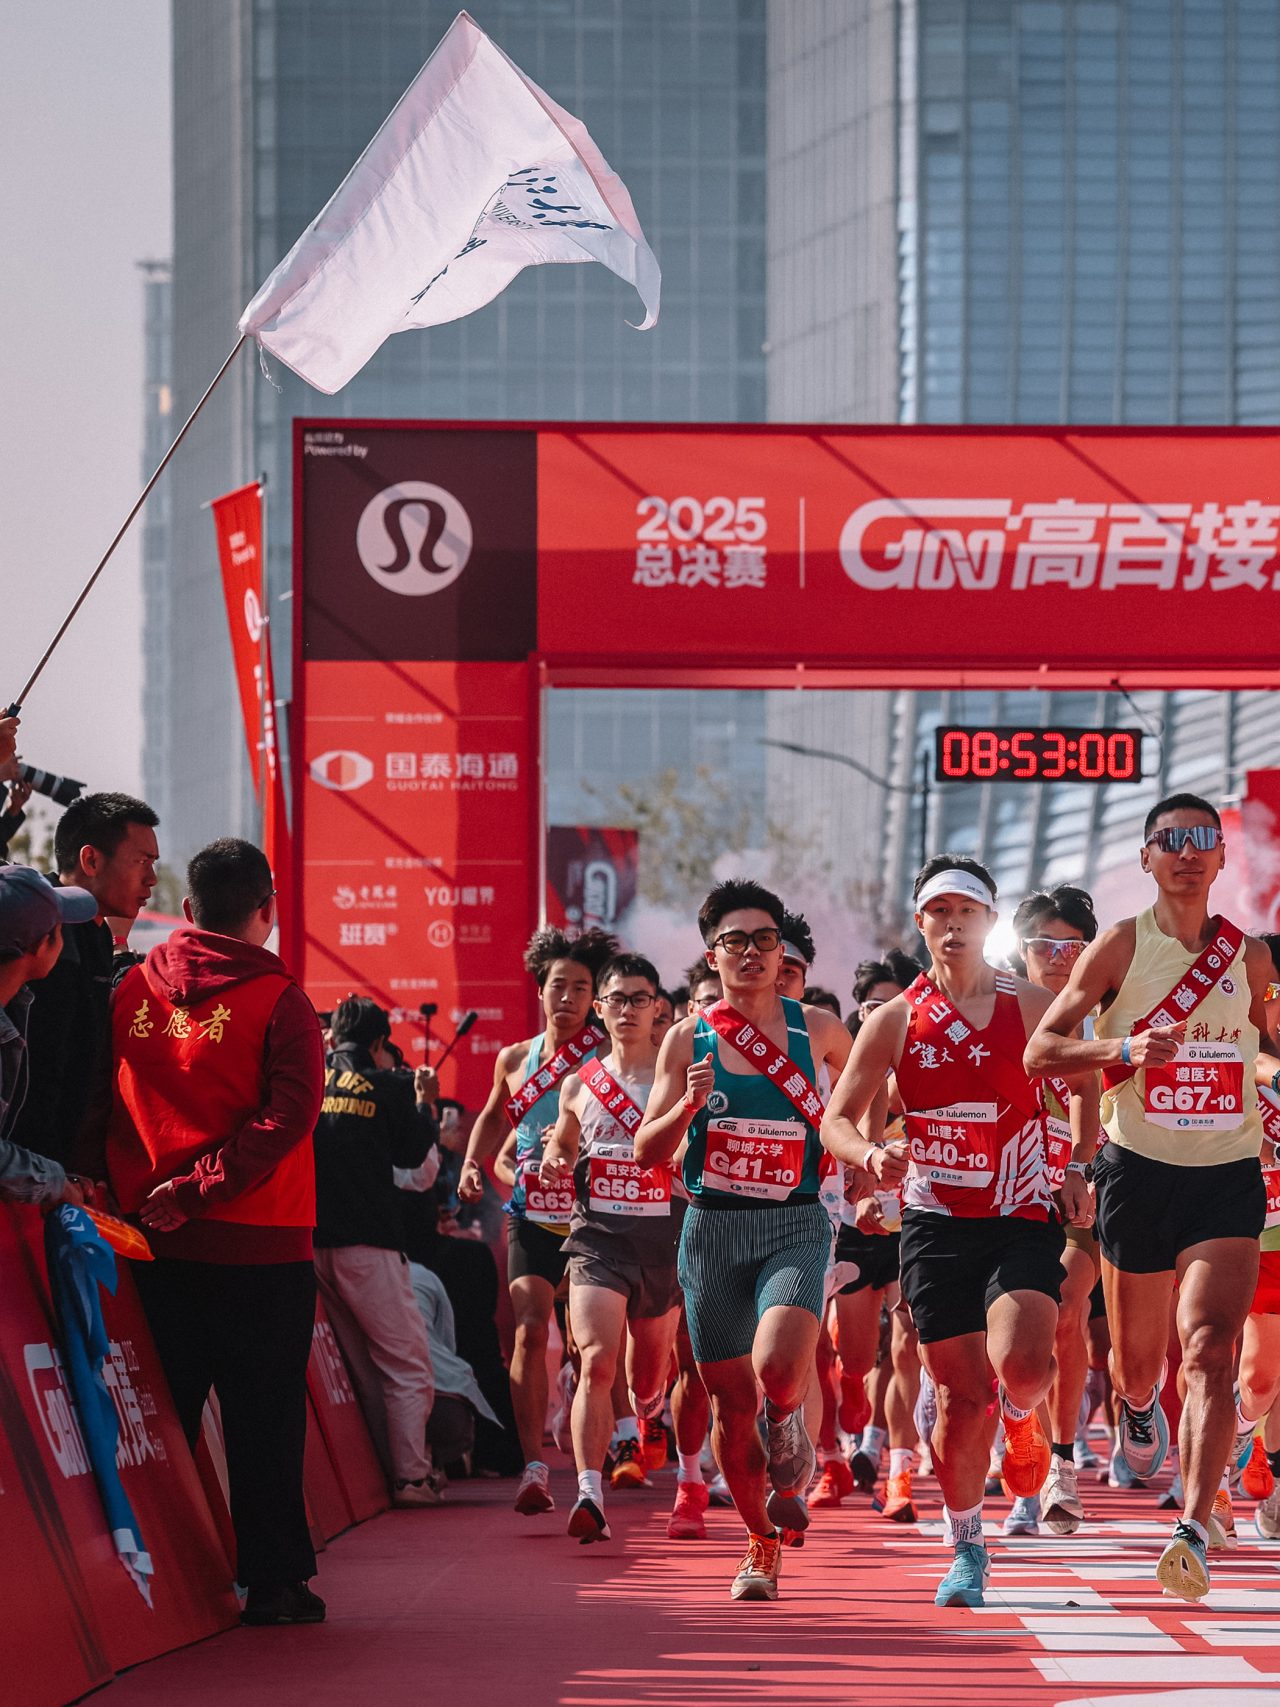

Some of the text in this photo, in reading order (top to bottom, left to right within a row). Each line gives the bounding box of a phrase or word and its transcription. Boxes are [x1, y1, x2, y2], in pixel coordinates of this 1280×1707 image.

[636, 496, 768, 542] 2025
[633, 545, 768, 588] 总决赛
[386, 752, 519, 780] 国泰海通
[942, 731, 1135, 779] 08:53:00
[387, 781, 519, 792] GUOTAI HAITONG
[1191, 968, 1213, 986] G67
[129, 999, 231, 1043] 志愿者
[928, 1001, 991, 1067] 山建大
[1199, 1049, 1236, 1059] lululemon
[336, 1070, 375, 1095] OFF
[768, 1055, 788, 1075] G41
[783, 1073, 822, 1117] 聊城
[1176, 1067, 1219, 1083] 遵医大
[1149, 1085, 1237, 1111] G67-10
[946, 1107, 987, 1119] lululemon
[757, 1126, 798, 1138] lululemon
[927, 1122, 967, 1142] 山建大
[726, 1138, 784, 1158] 聊城大学
[910, 1136, 989, 1169] G40-10
[709, 1150, 796, 1184] G41-10
[593, 1177, 666, 1201] G56-10
